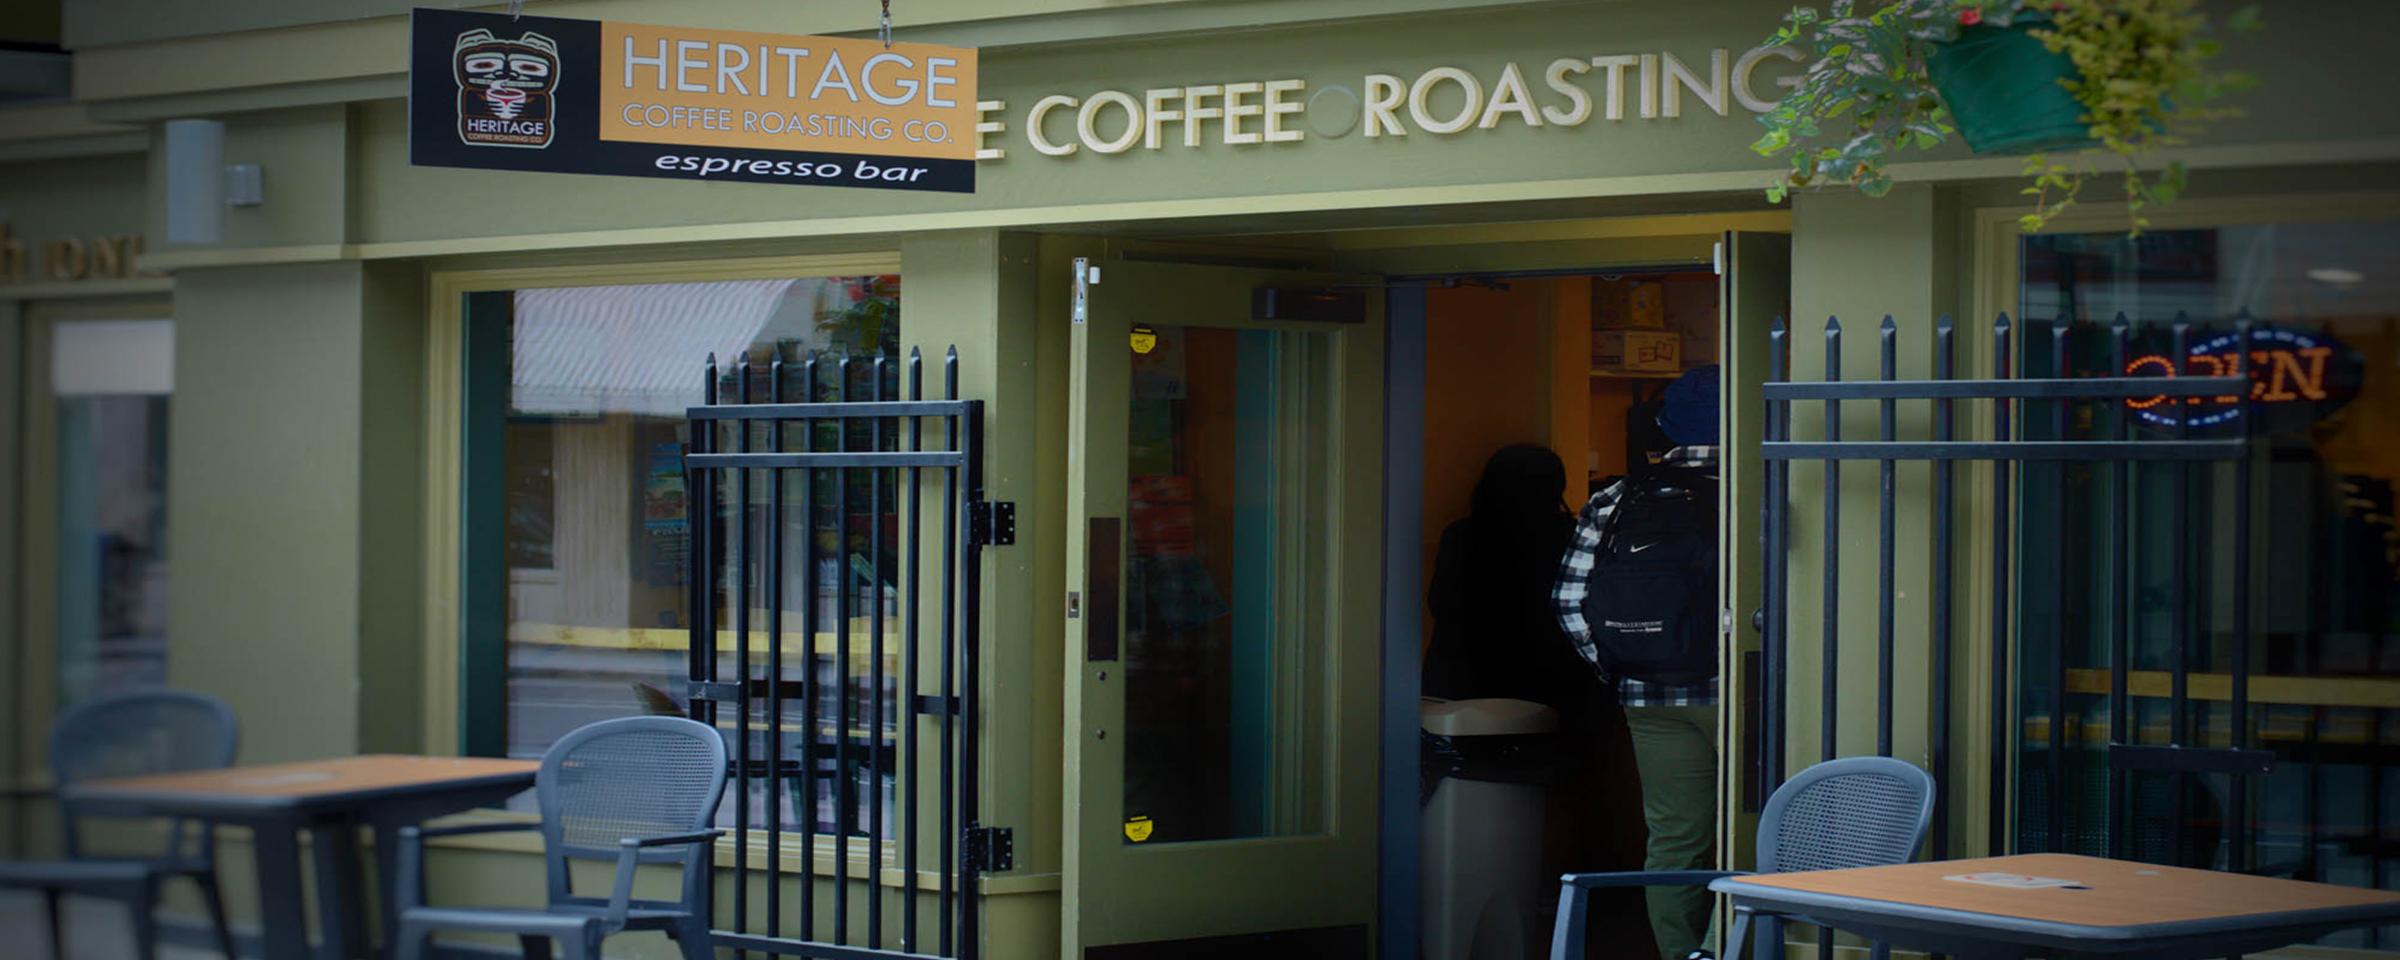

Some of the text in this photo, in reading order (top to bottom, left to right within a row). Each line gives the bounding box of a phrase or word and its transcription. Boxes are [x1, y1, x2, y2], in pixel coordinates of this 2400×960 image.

[621, 35, 958, 108] HERITAGE
[1026, 79, 1305, 155] COFFEE
[1364, 46, 1807, 137] ROASTING
[467, 118, 545, 135] HERITAGE
[622, 103, 954, 144] COFFEE ROASTING CO.
[655, 154, 928, 182] espresso bar
